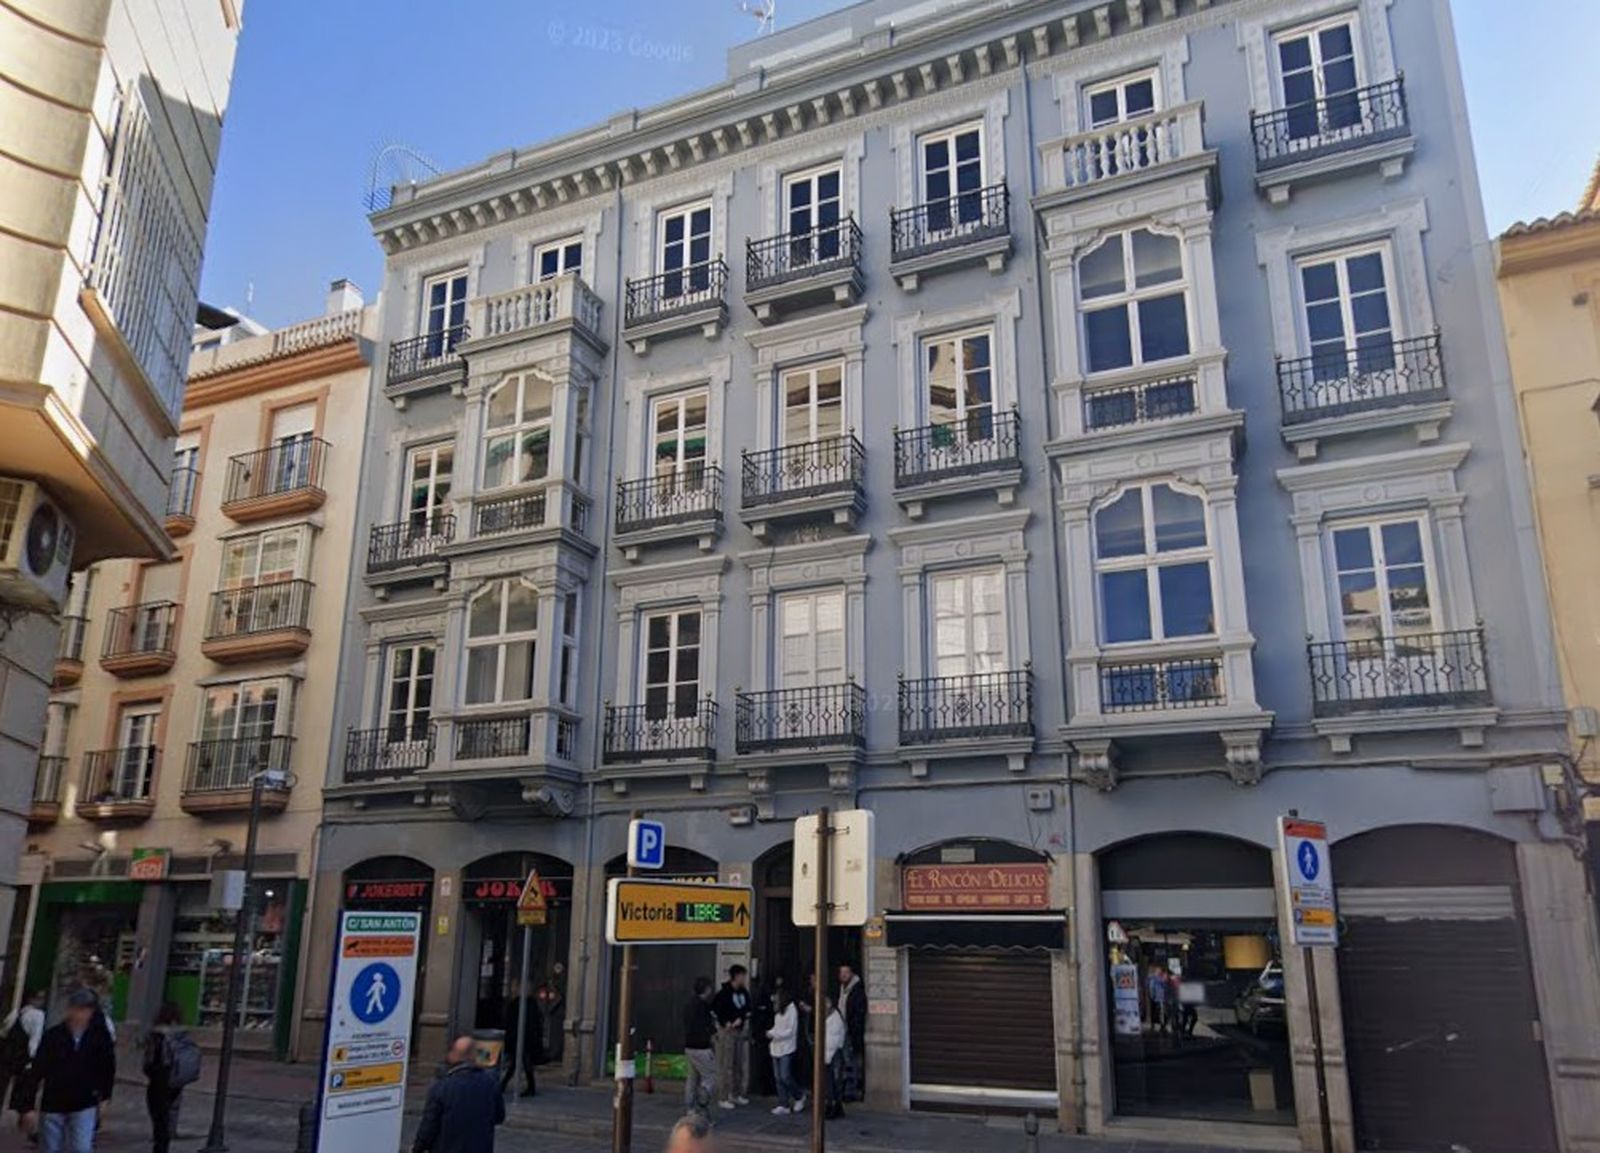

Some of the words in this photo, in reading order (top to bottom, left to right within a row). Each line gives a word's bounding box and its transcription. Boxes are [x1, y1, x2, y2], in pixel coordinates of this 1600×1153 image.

[642, 829, 657, 859] P
[928, 868, 981, 888] RINCÓN
[988, 868, 1045, 888] DELICIAS
[362, 883, 425, 898] JOKERBET
[620, 902, 673, 921] Victoria
[686, 903, 721, 921] LIBRE
[360, 919, 381, 929] SAN
[382, 918, 415, 929] ANTÓN
